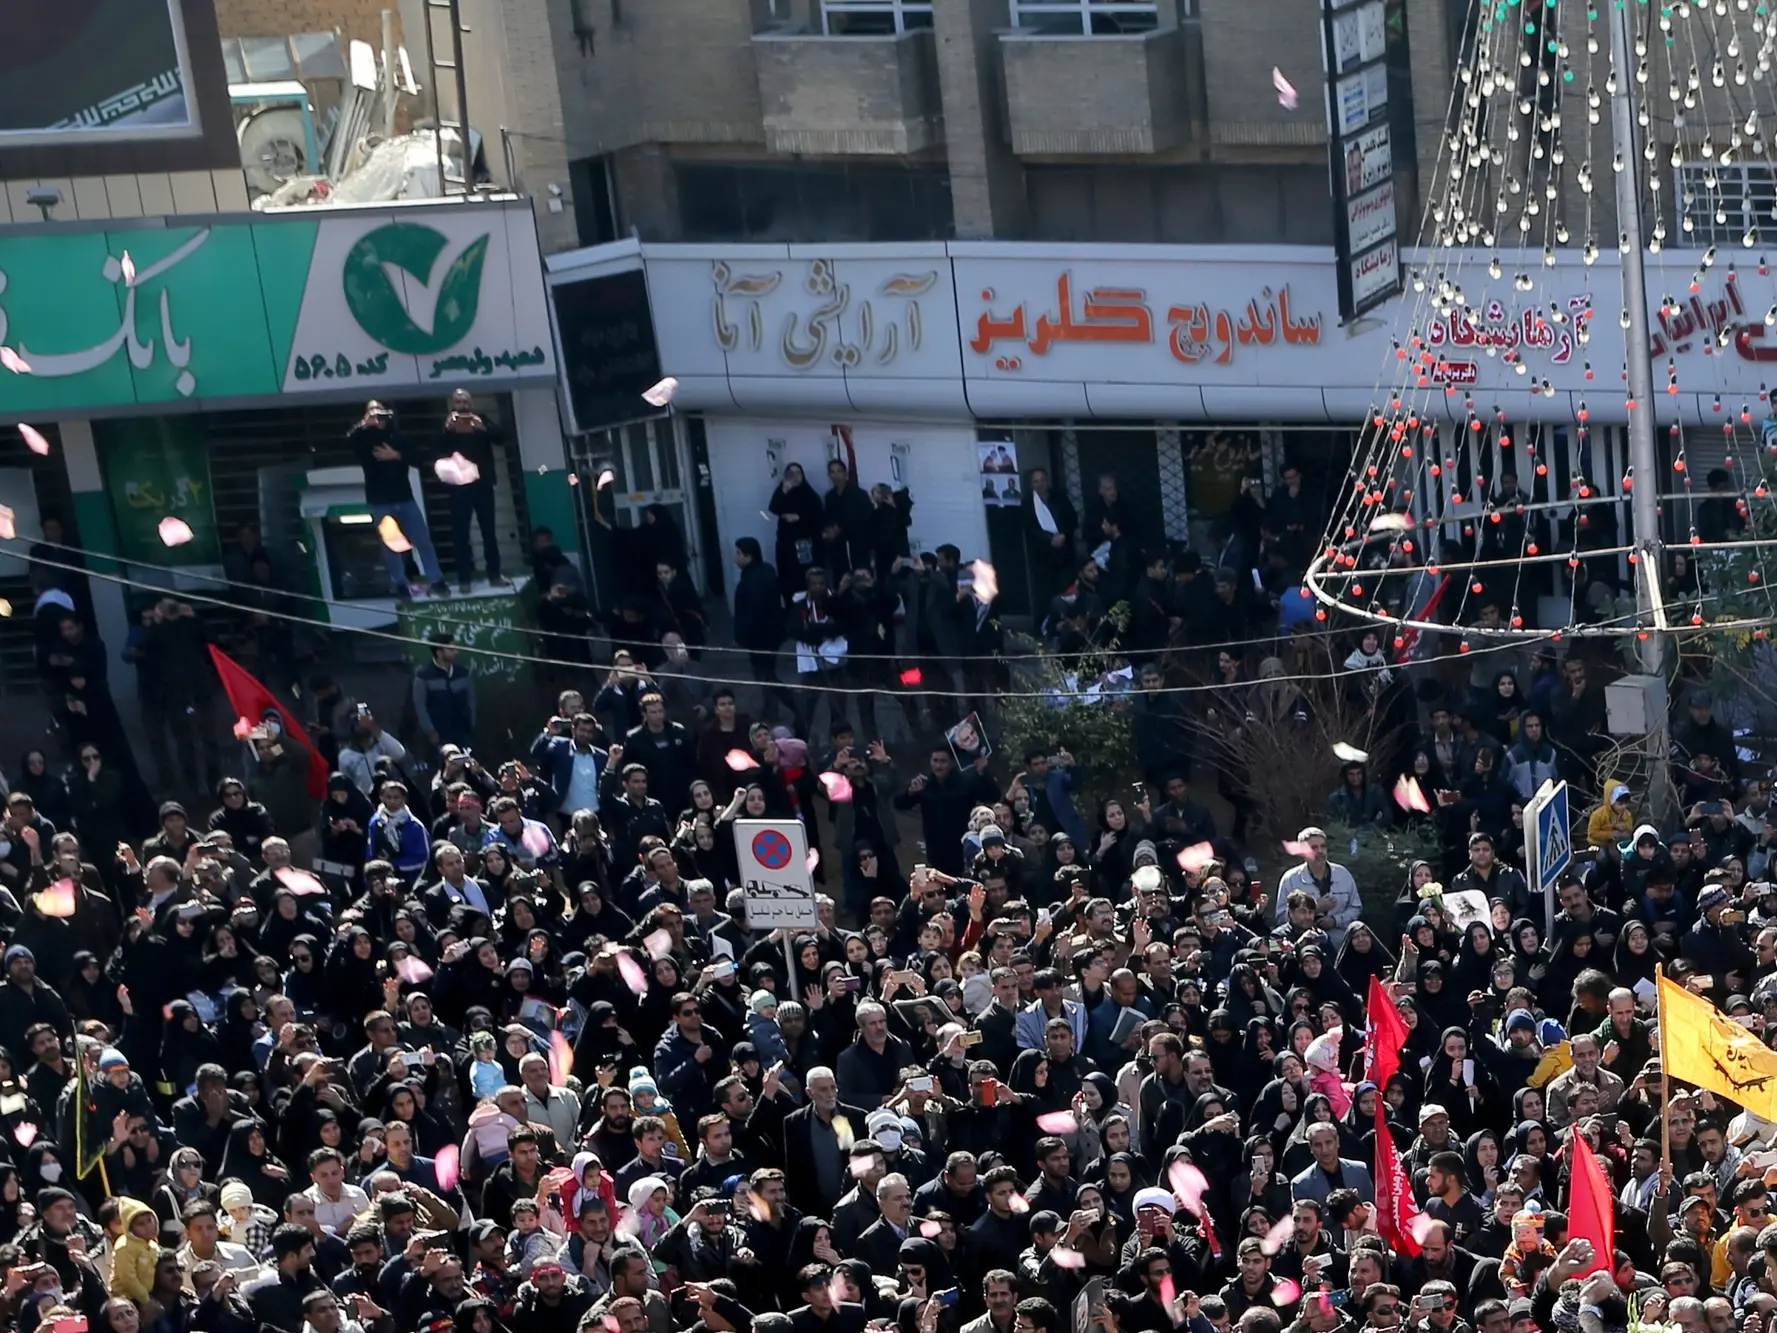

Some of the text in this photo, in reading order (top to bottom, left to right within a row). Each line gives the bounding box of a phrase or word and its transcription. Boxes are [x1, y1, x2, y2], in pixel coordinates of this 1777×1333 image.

[19, 228, 211, 397] بانک
[781, 257, 939, 369] آرایشی
[1167, 282, 1324, 364] ساندویچ
[1426, 292, 1594, 366] آزمایشگاه
